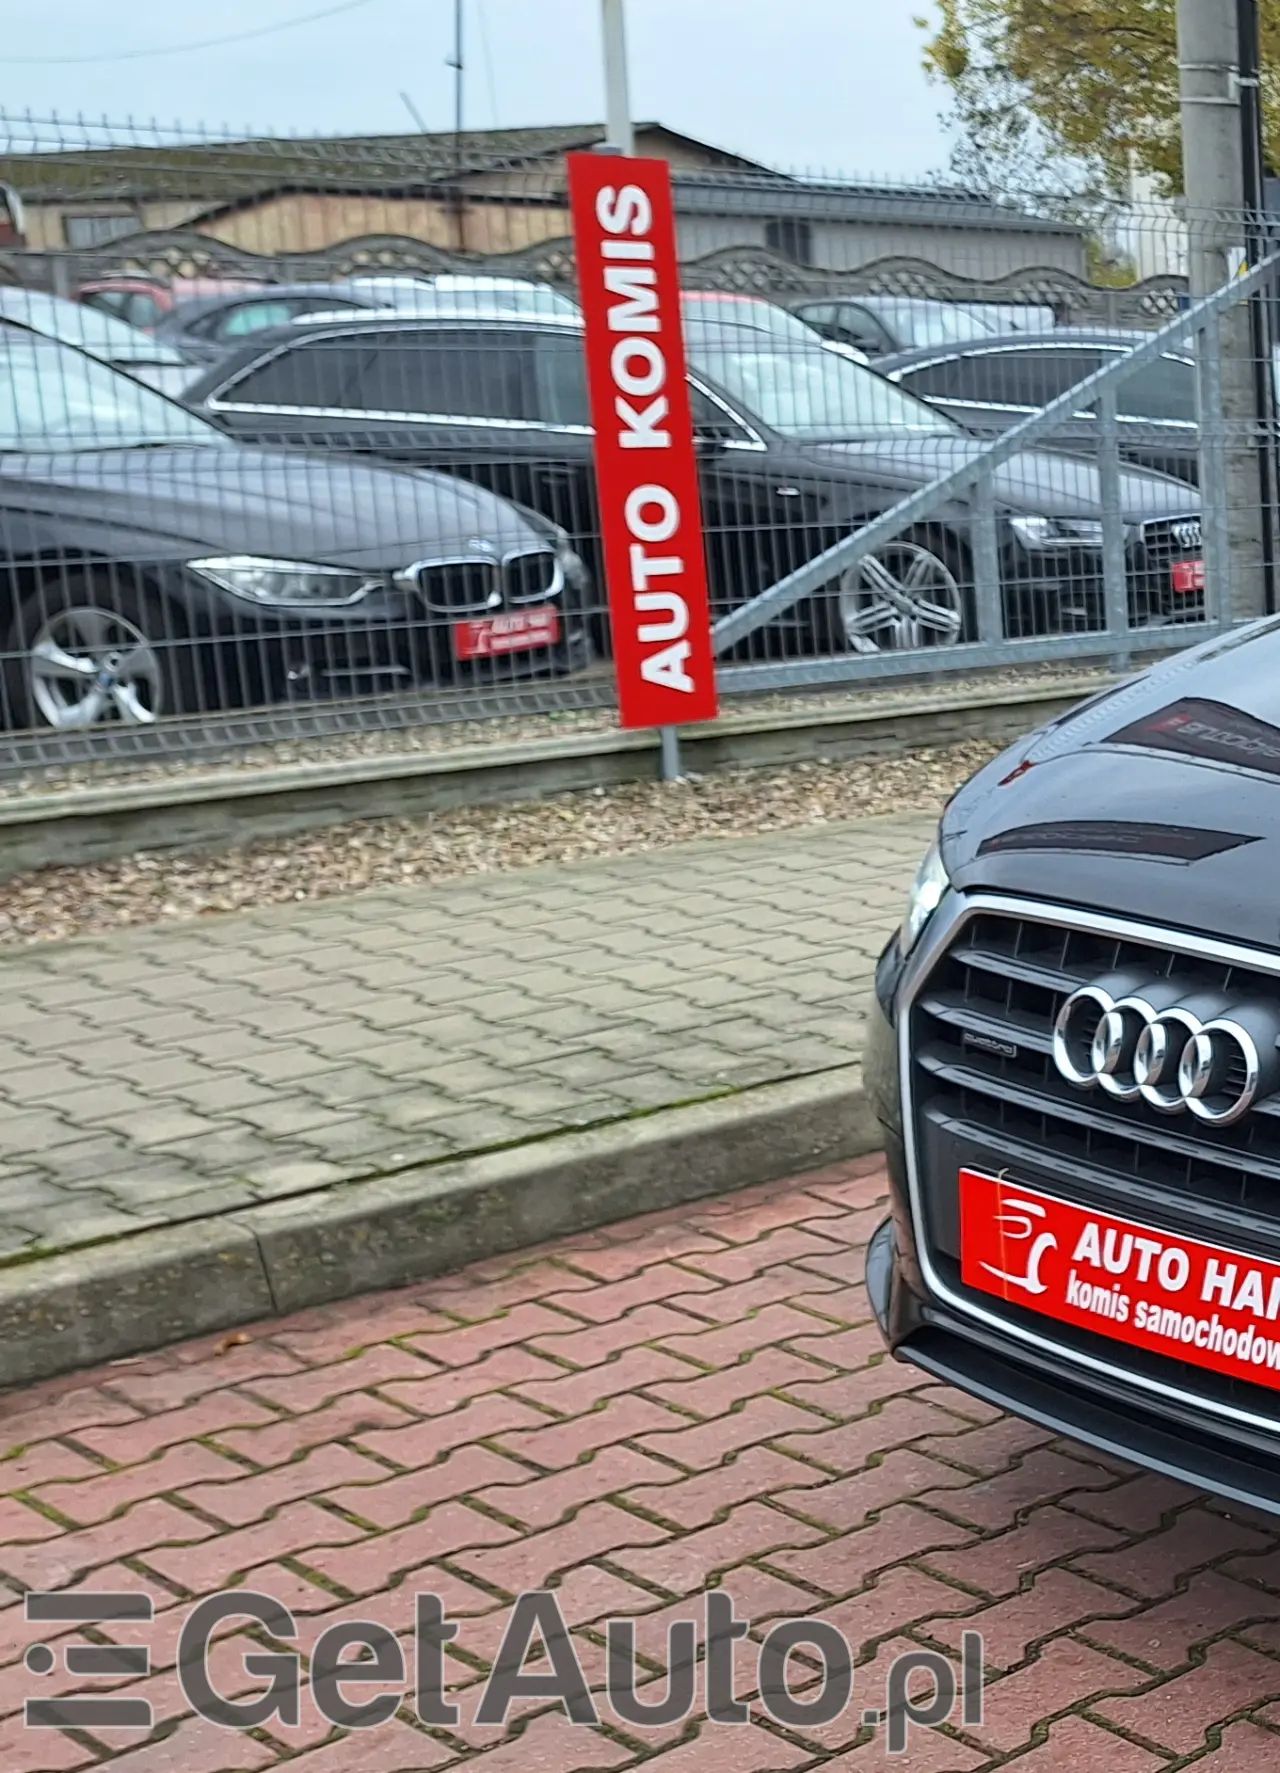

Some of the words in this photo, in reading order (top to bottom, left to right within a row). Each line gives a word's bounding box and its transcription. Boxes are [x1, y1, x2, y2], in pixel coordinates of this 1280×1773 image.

[596, 183, 673, 450] KOMIS
[624, 483, 696, 693] AUTO
[1066, 1270, 1130, 1322] komis
[1073, 1222, 1190, 1292] AUTO
